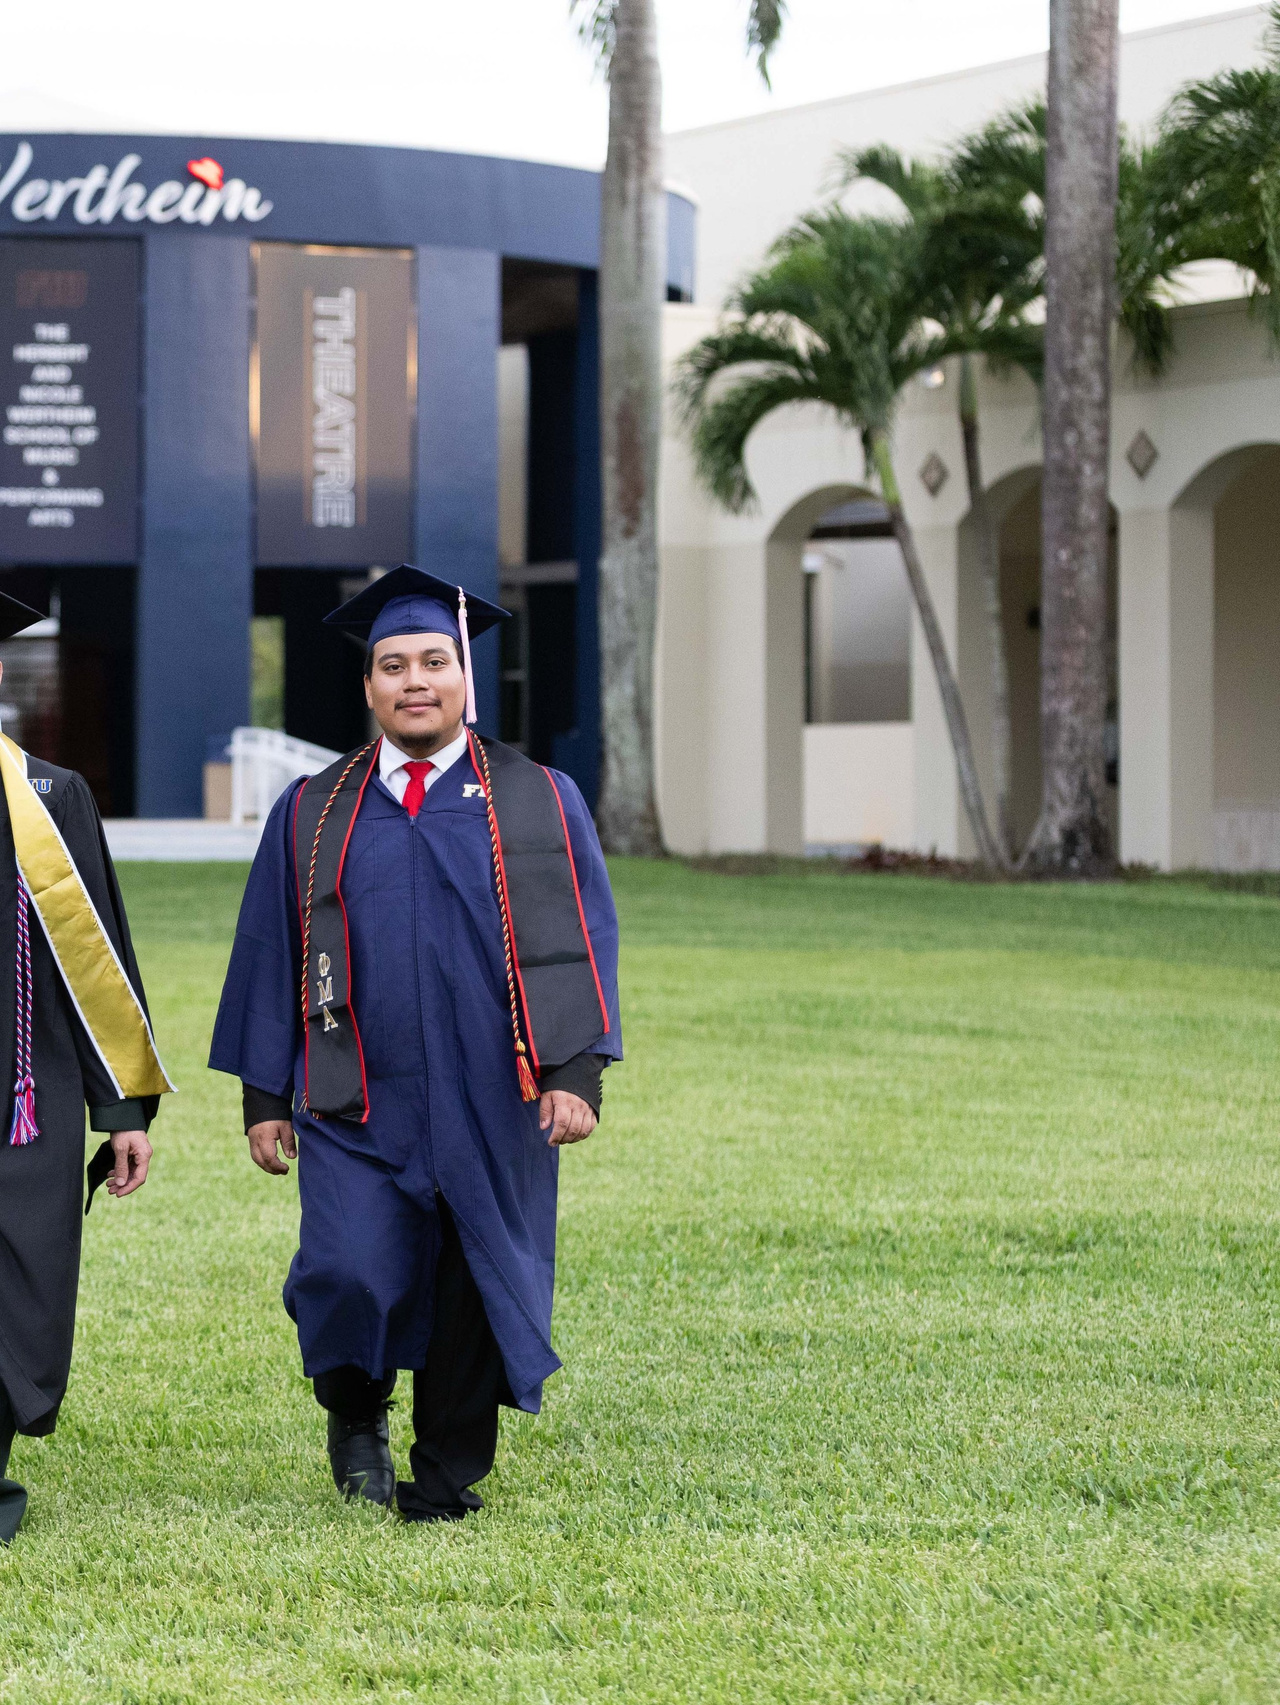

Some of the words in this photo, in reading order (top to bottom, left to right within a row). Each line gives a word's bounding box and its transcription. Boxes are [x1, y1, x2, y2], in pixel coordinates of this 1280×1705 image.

[34, 322, 70, 342] THE
[31, 364, 72, 384] AND
[6, 405, 96, 425] WERTHEIM
[312, 286, 356, 528] THEATRE
[3, 425, 71, 445] SCHOOL
[71, 425, 100, 445] OF
[22, 446, 79, 466] MUSIC
[27, 508, 74, 528] ARTS
